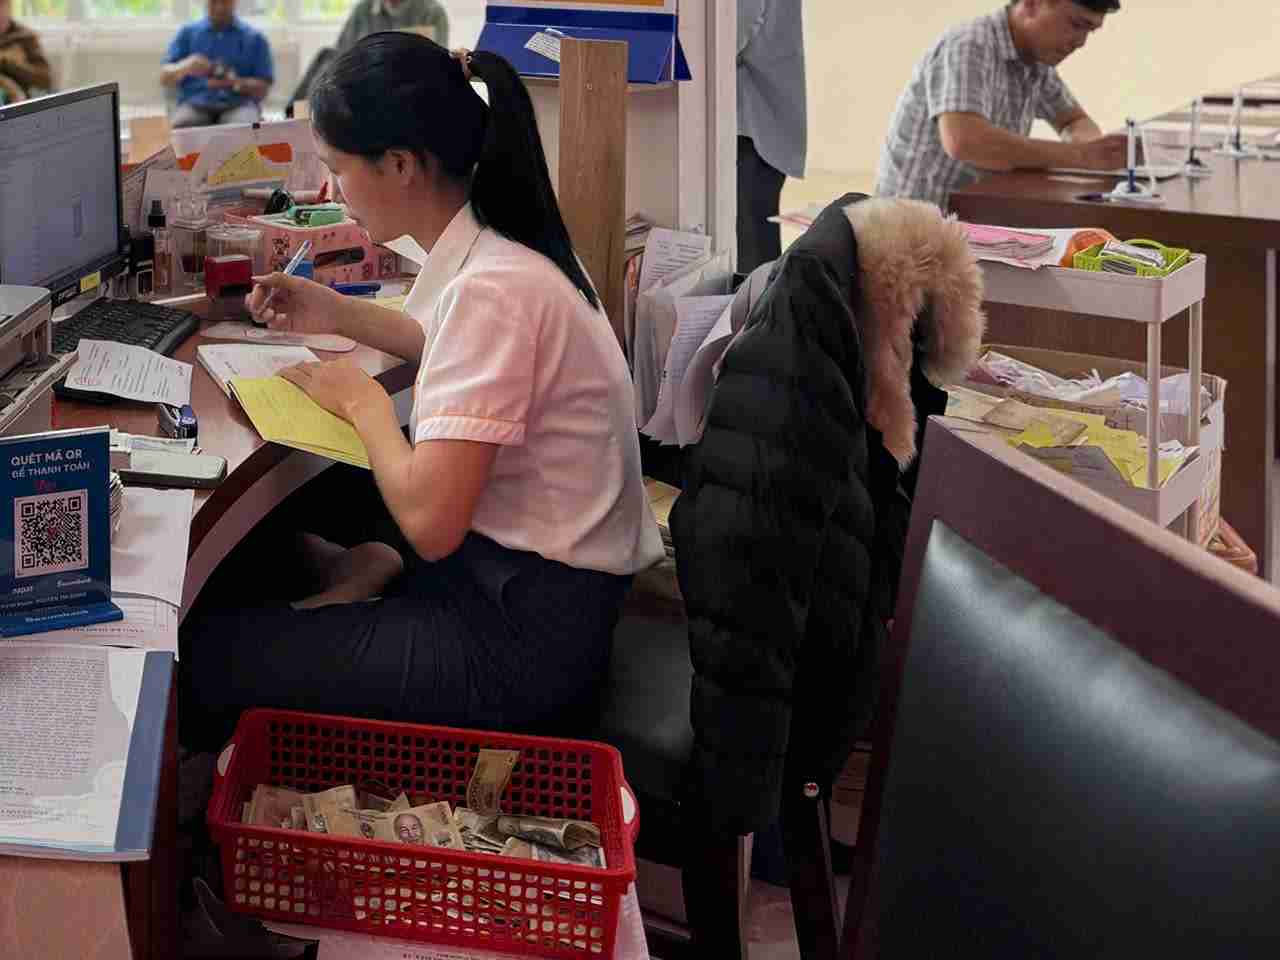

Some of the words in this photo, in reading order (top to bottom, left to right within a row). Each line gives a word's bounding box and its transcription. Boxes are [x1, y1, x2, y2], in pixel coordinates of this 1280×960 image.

[10, 452, 42, 466] QUÉT
[45, 449, 63, 462] MÃ
[65, 448, 82, 461] QR
[27, 465, 61, 477] THANH
